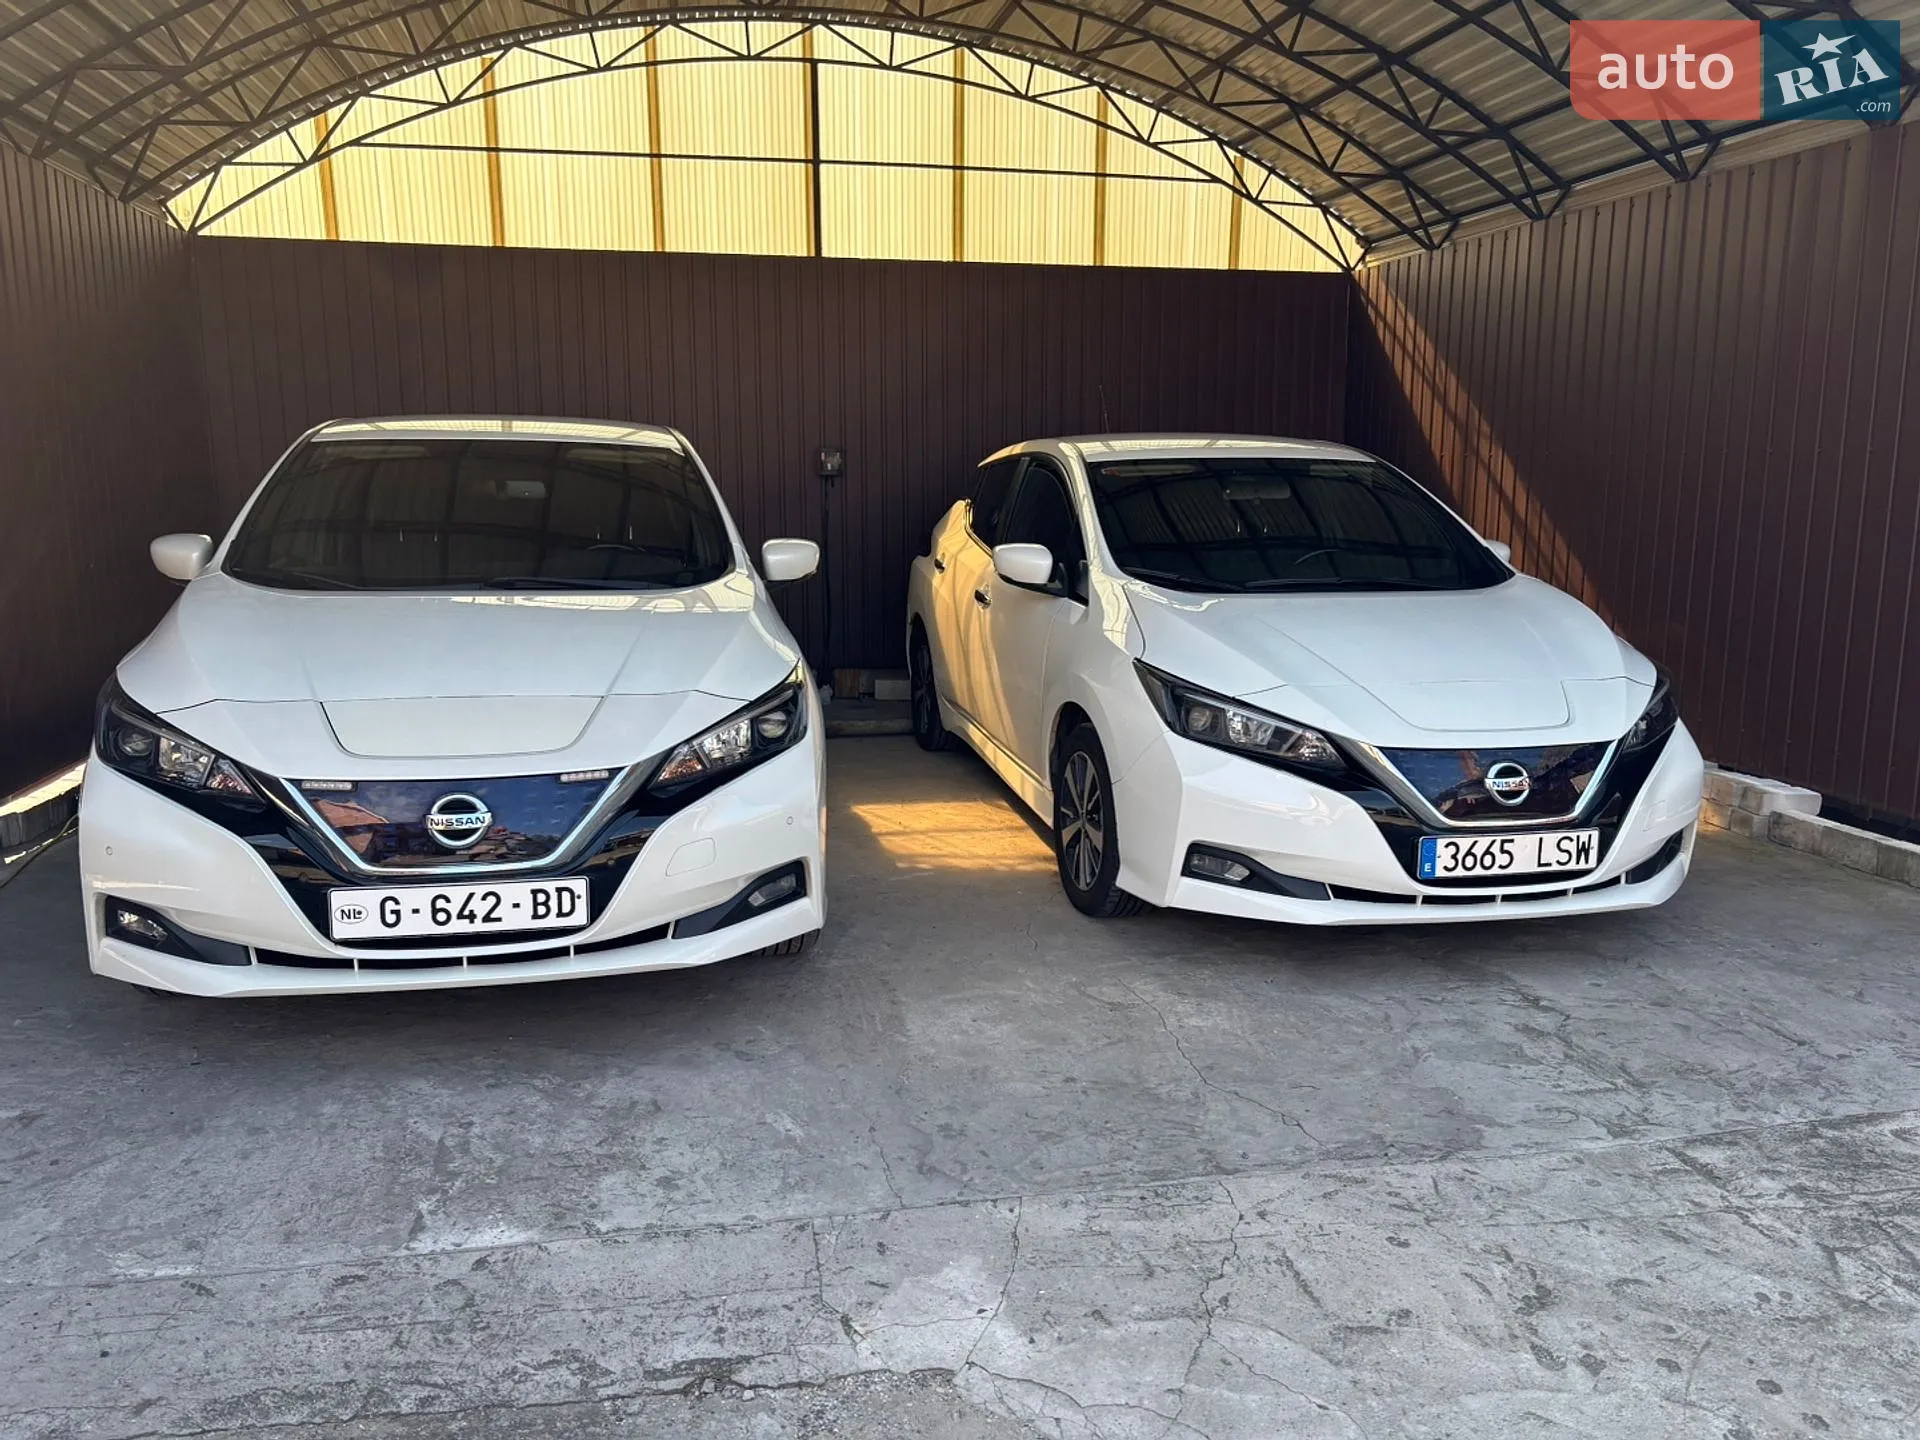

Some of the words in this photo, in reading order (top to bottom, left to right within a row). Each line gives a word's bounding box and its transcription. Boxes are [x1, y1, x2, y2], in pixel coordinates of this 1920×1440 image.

[429, 815, 486, 827] NISSAN
[1442, 839, 1515, 872] 3665
[1537, 833, 1592, 868] LSW
[1424, 863, 1431, 872] E
[340, 910, 363, 920] NL
